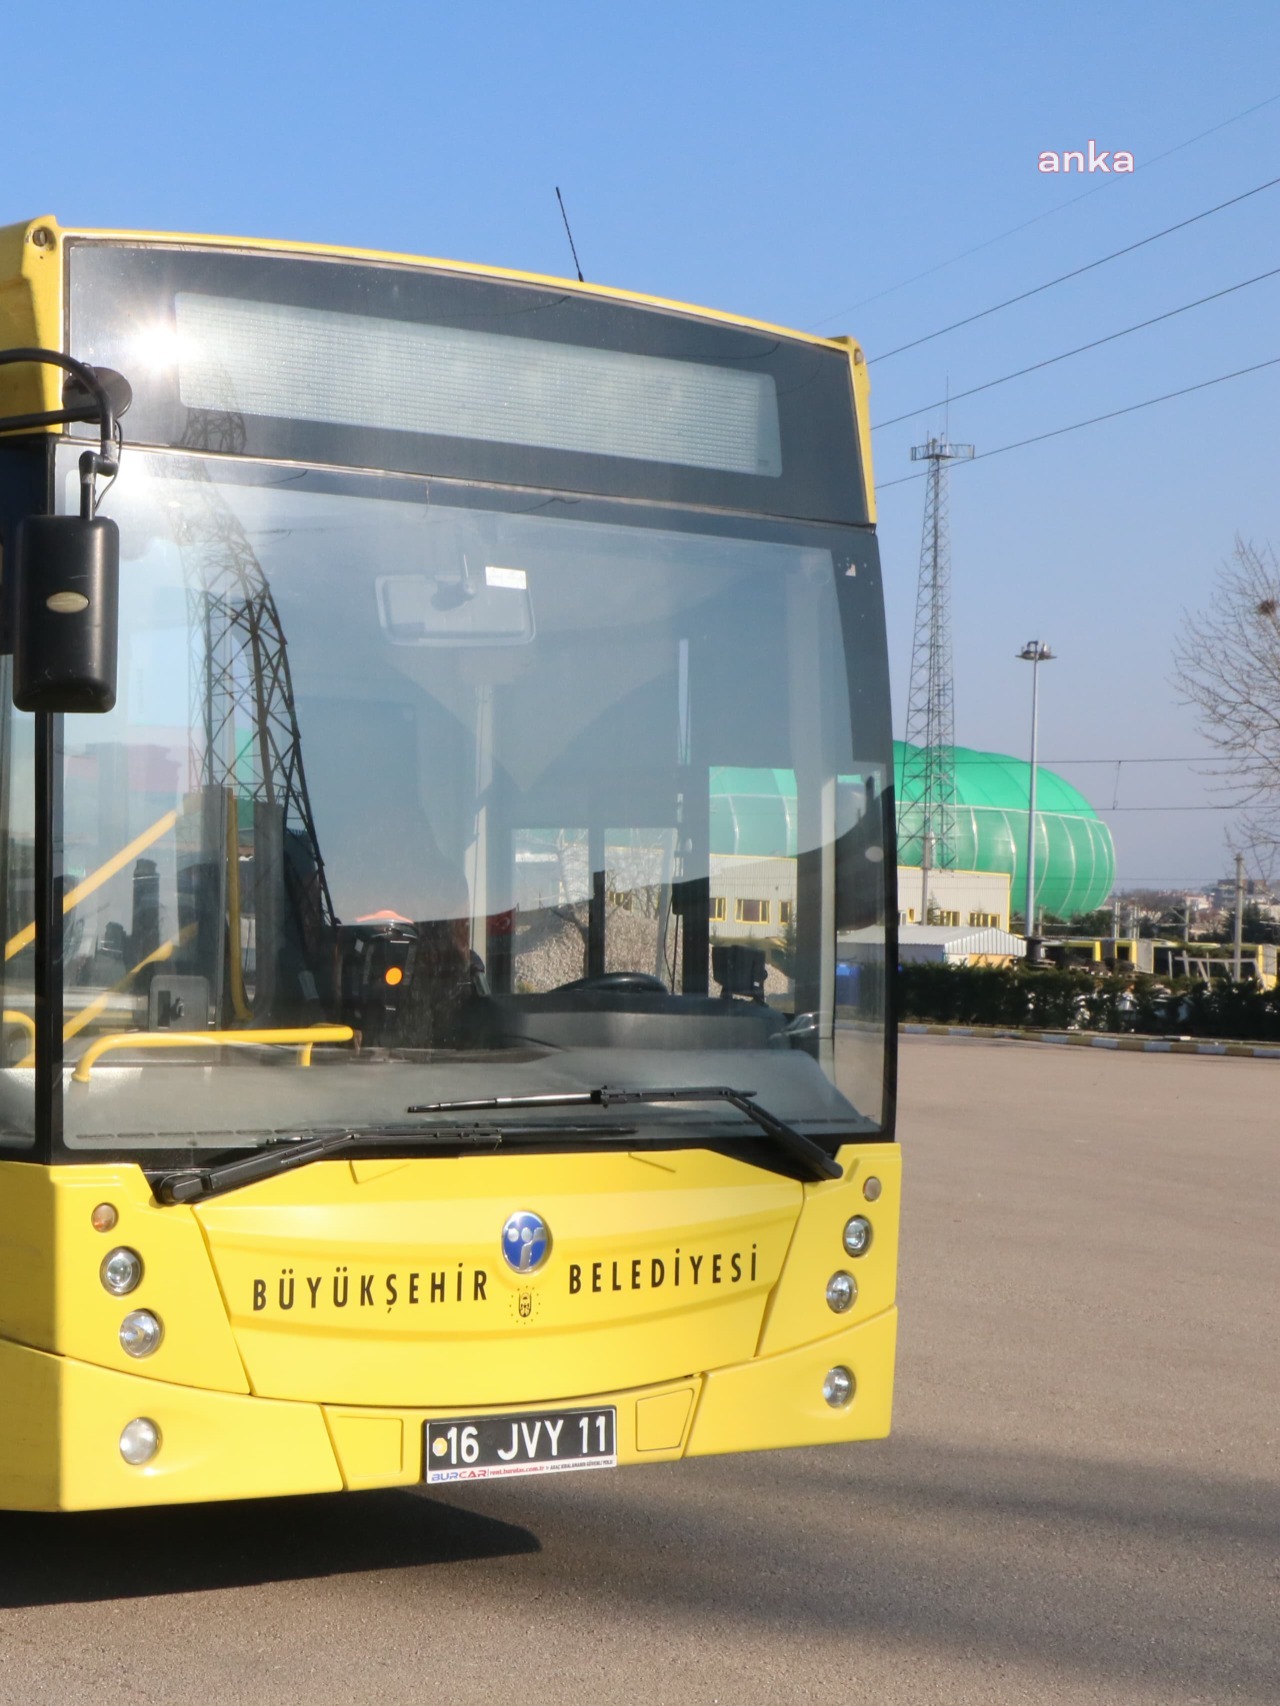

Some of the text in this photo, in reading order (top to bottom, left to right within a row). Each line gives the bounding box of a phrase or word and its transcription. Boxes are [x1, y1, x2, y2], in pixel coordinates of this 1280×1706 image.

[252, 1243, 758, 1314] BÜYÜKŞEHİR BELEDİYESİ
[447, 1415, 606, 1465] 16 JVY 11
[431, 1469, 488, 1482] BURCAR
